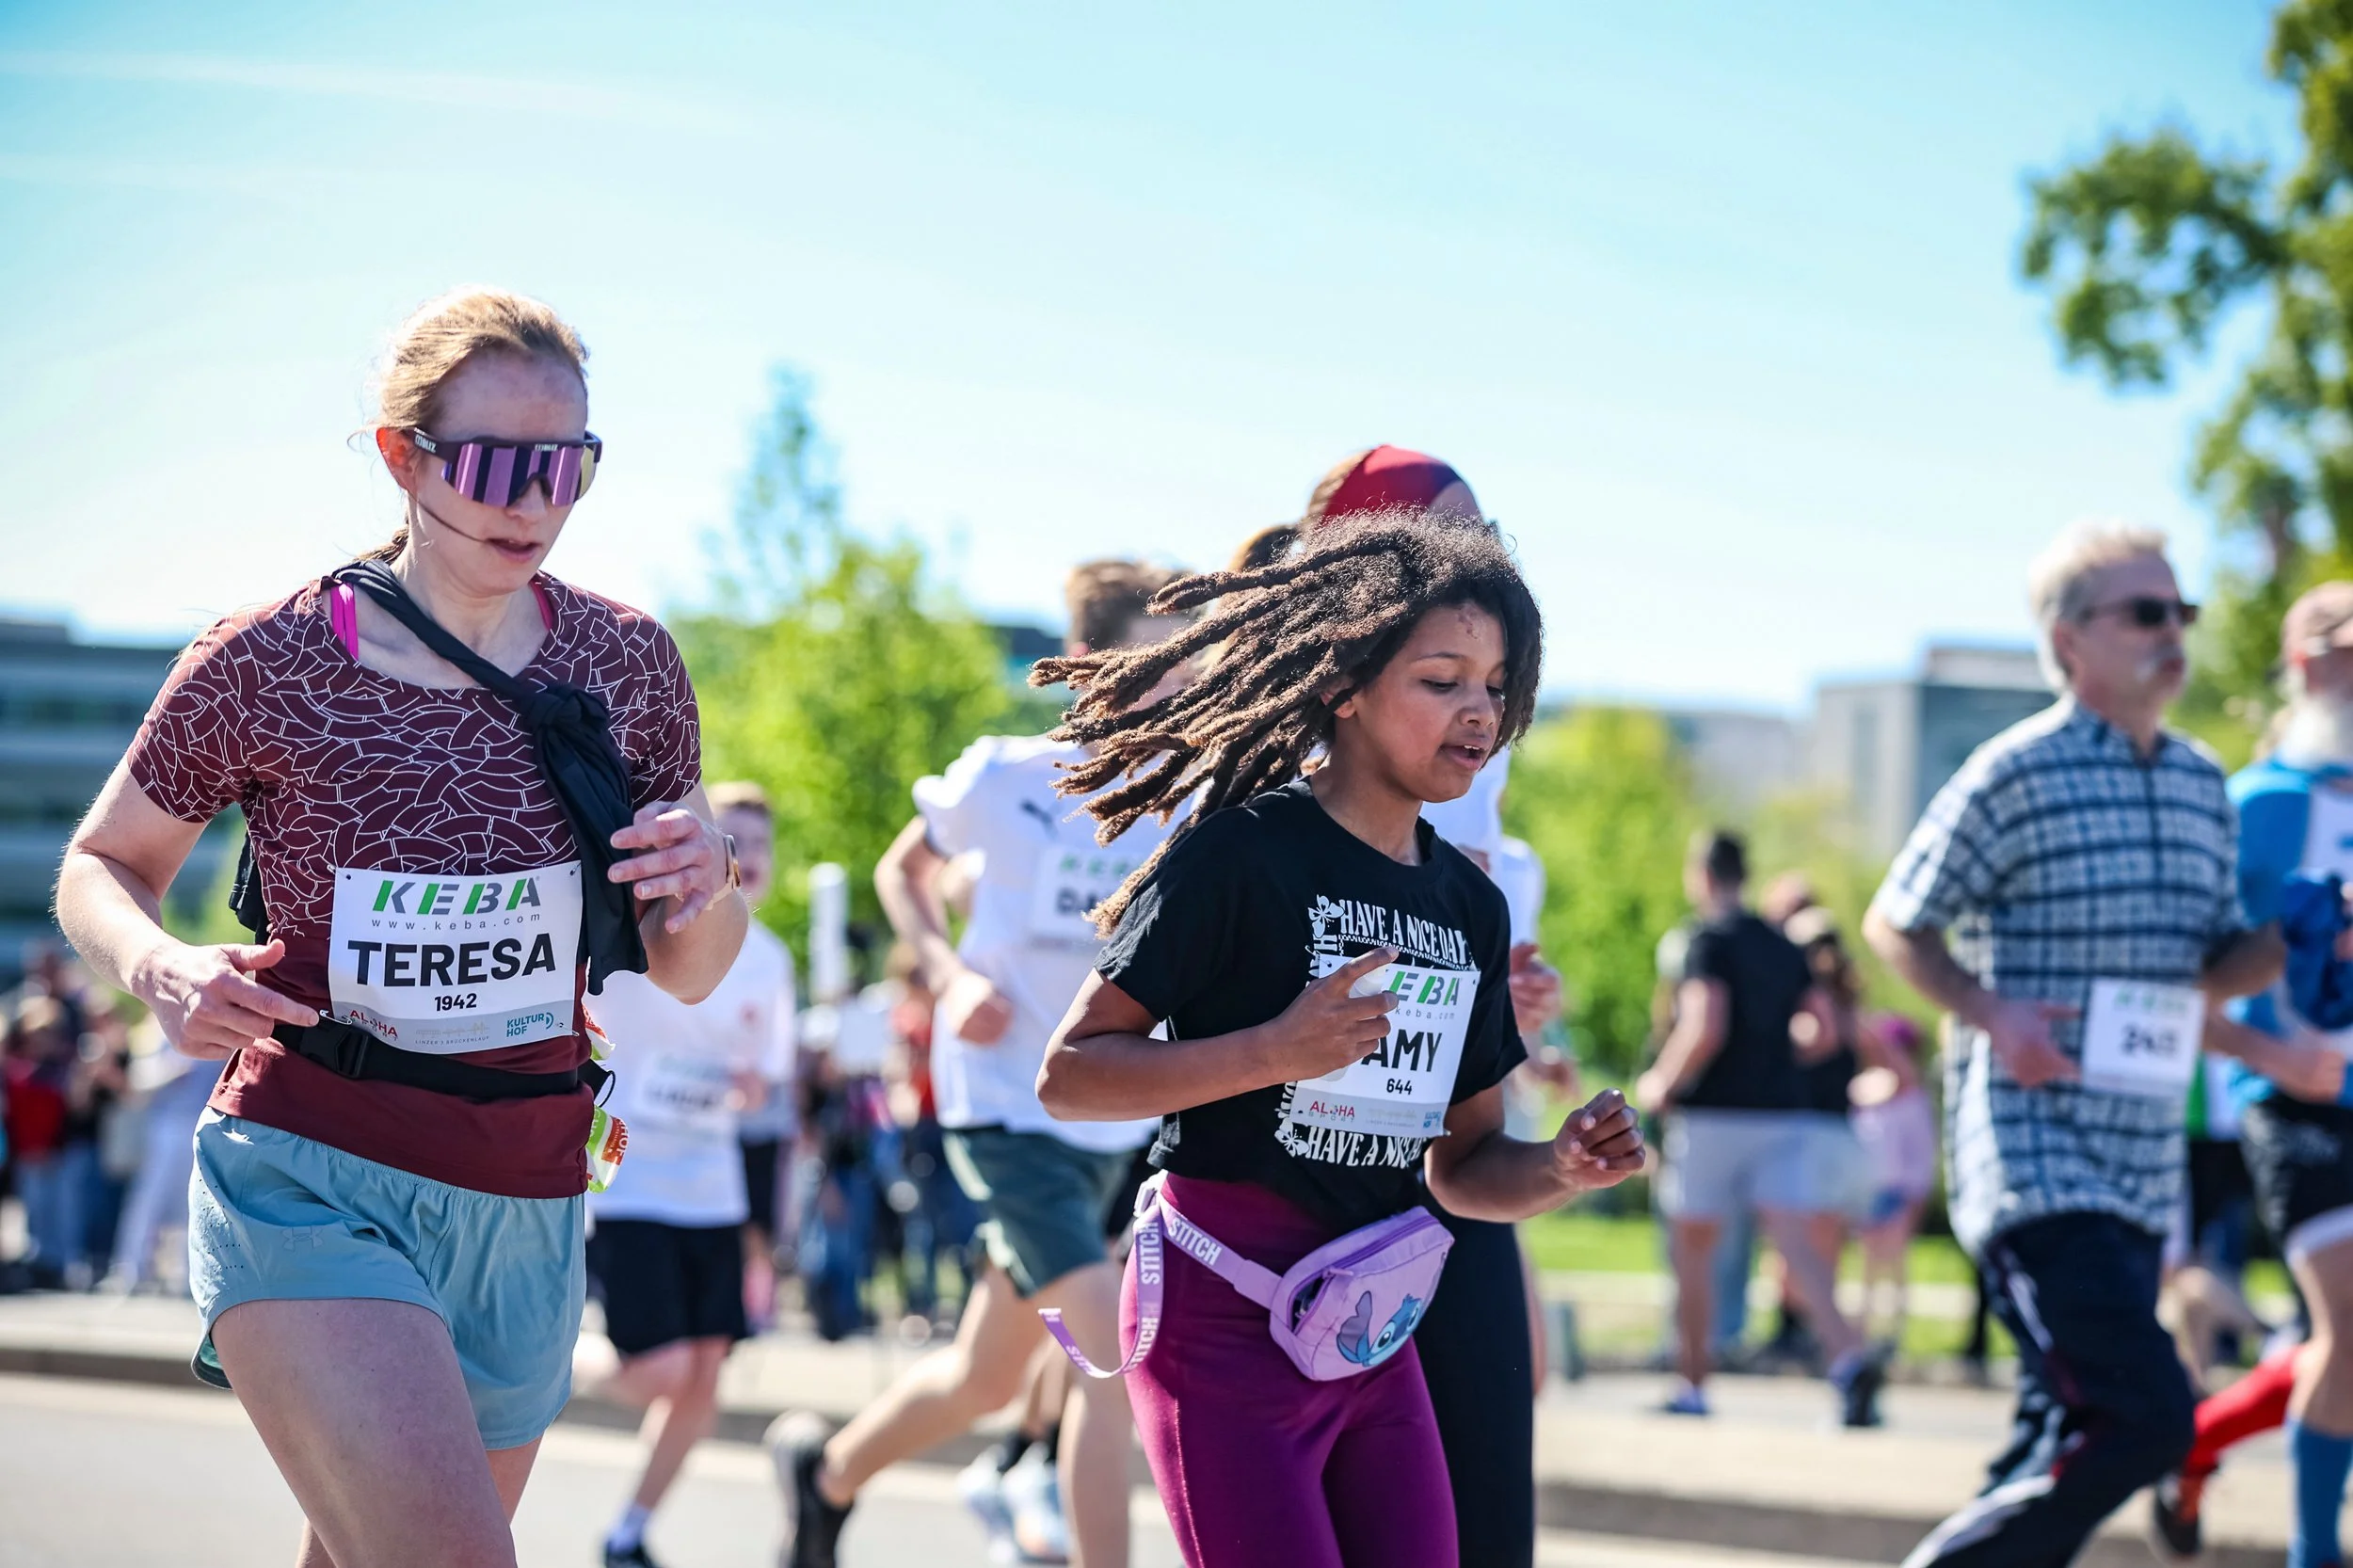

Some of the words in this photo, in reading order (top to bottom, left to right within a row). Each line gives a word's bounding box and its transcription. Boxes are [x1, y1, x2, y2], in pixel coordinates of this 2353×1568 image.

[372, 876, 541, 916] KEBA
[371, 912, 540, 931] www.keba.com
[1338, 899, 1388, 941] HAVE
[1392, 909, 1404, 946] A
[1406, 914, 1440, 957] NICE
[1438, 925, 1468, 965] DAY
[347, 933, 557, 987] TERESA
[434, 993, 477, 1012] 1942
[1388, 970, 1460, 1005] EBA
[505, 1025, 528, 1037] HOF
[506, 1012, 545, 1029] KULTUR
[1361, 1029, 1443, 1073] AMY
[1385, 1078, 1413, 1096] 644
[1305, 1125, 1365, 1167] HAVE
[1361, 1133, 1379, 1167] A
[1168, 1216, 1223, 1266] STITCH
